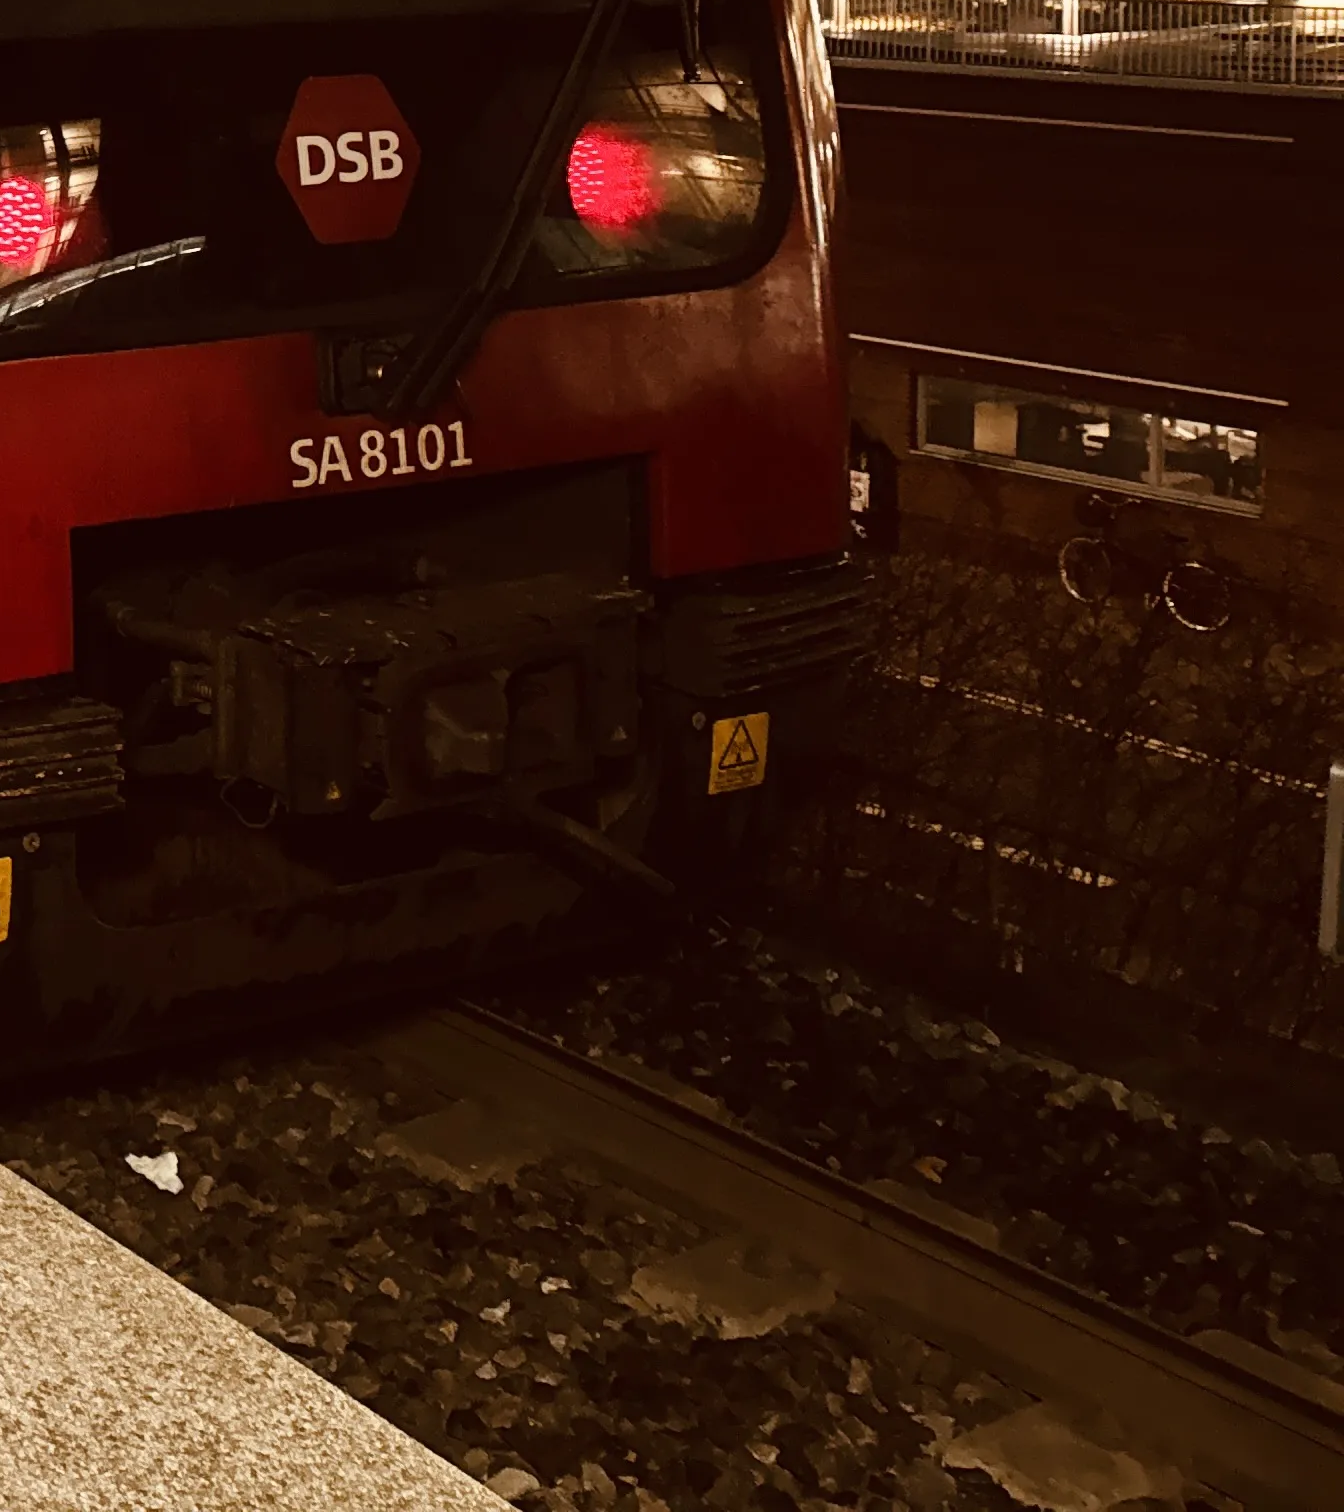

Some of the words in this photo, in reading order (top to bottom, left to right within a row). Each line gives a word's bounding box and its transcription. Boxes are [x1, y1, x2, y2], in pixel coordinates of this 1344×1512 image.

[297, 130, 403, 186] DSB
[290, 435, 353, 488] SA
[359, 420, 473, 478] 8101
